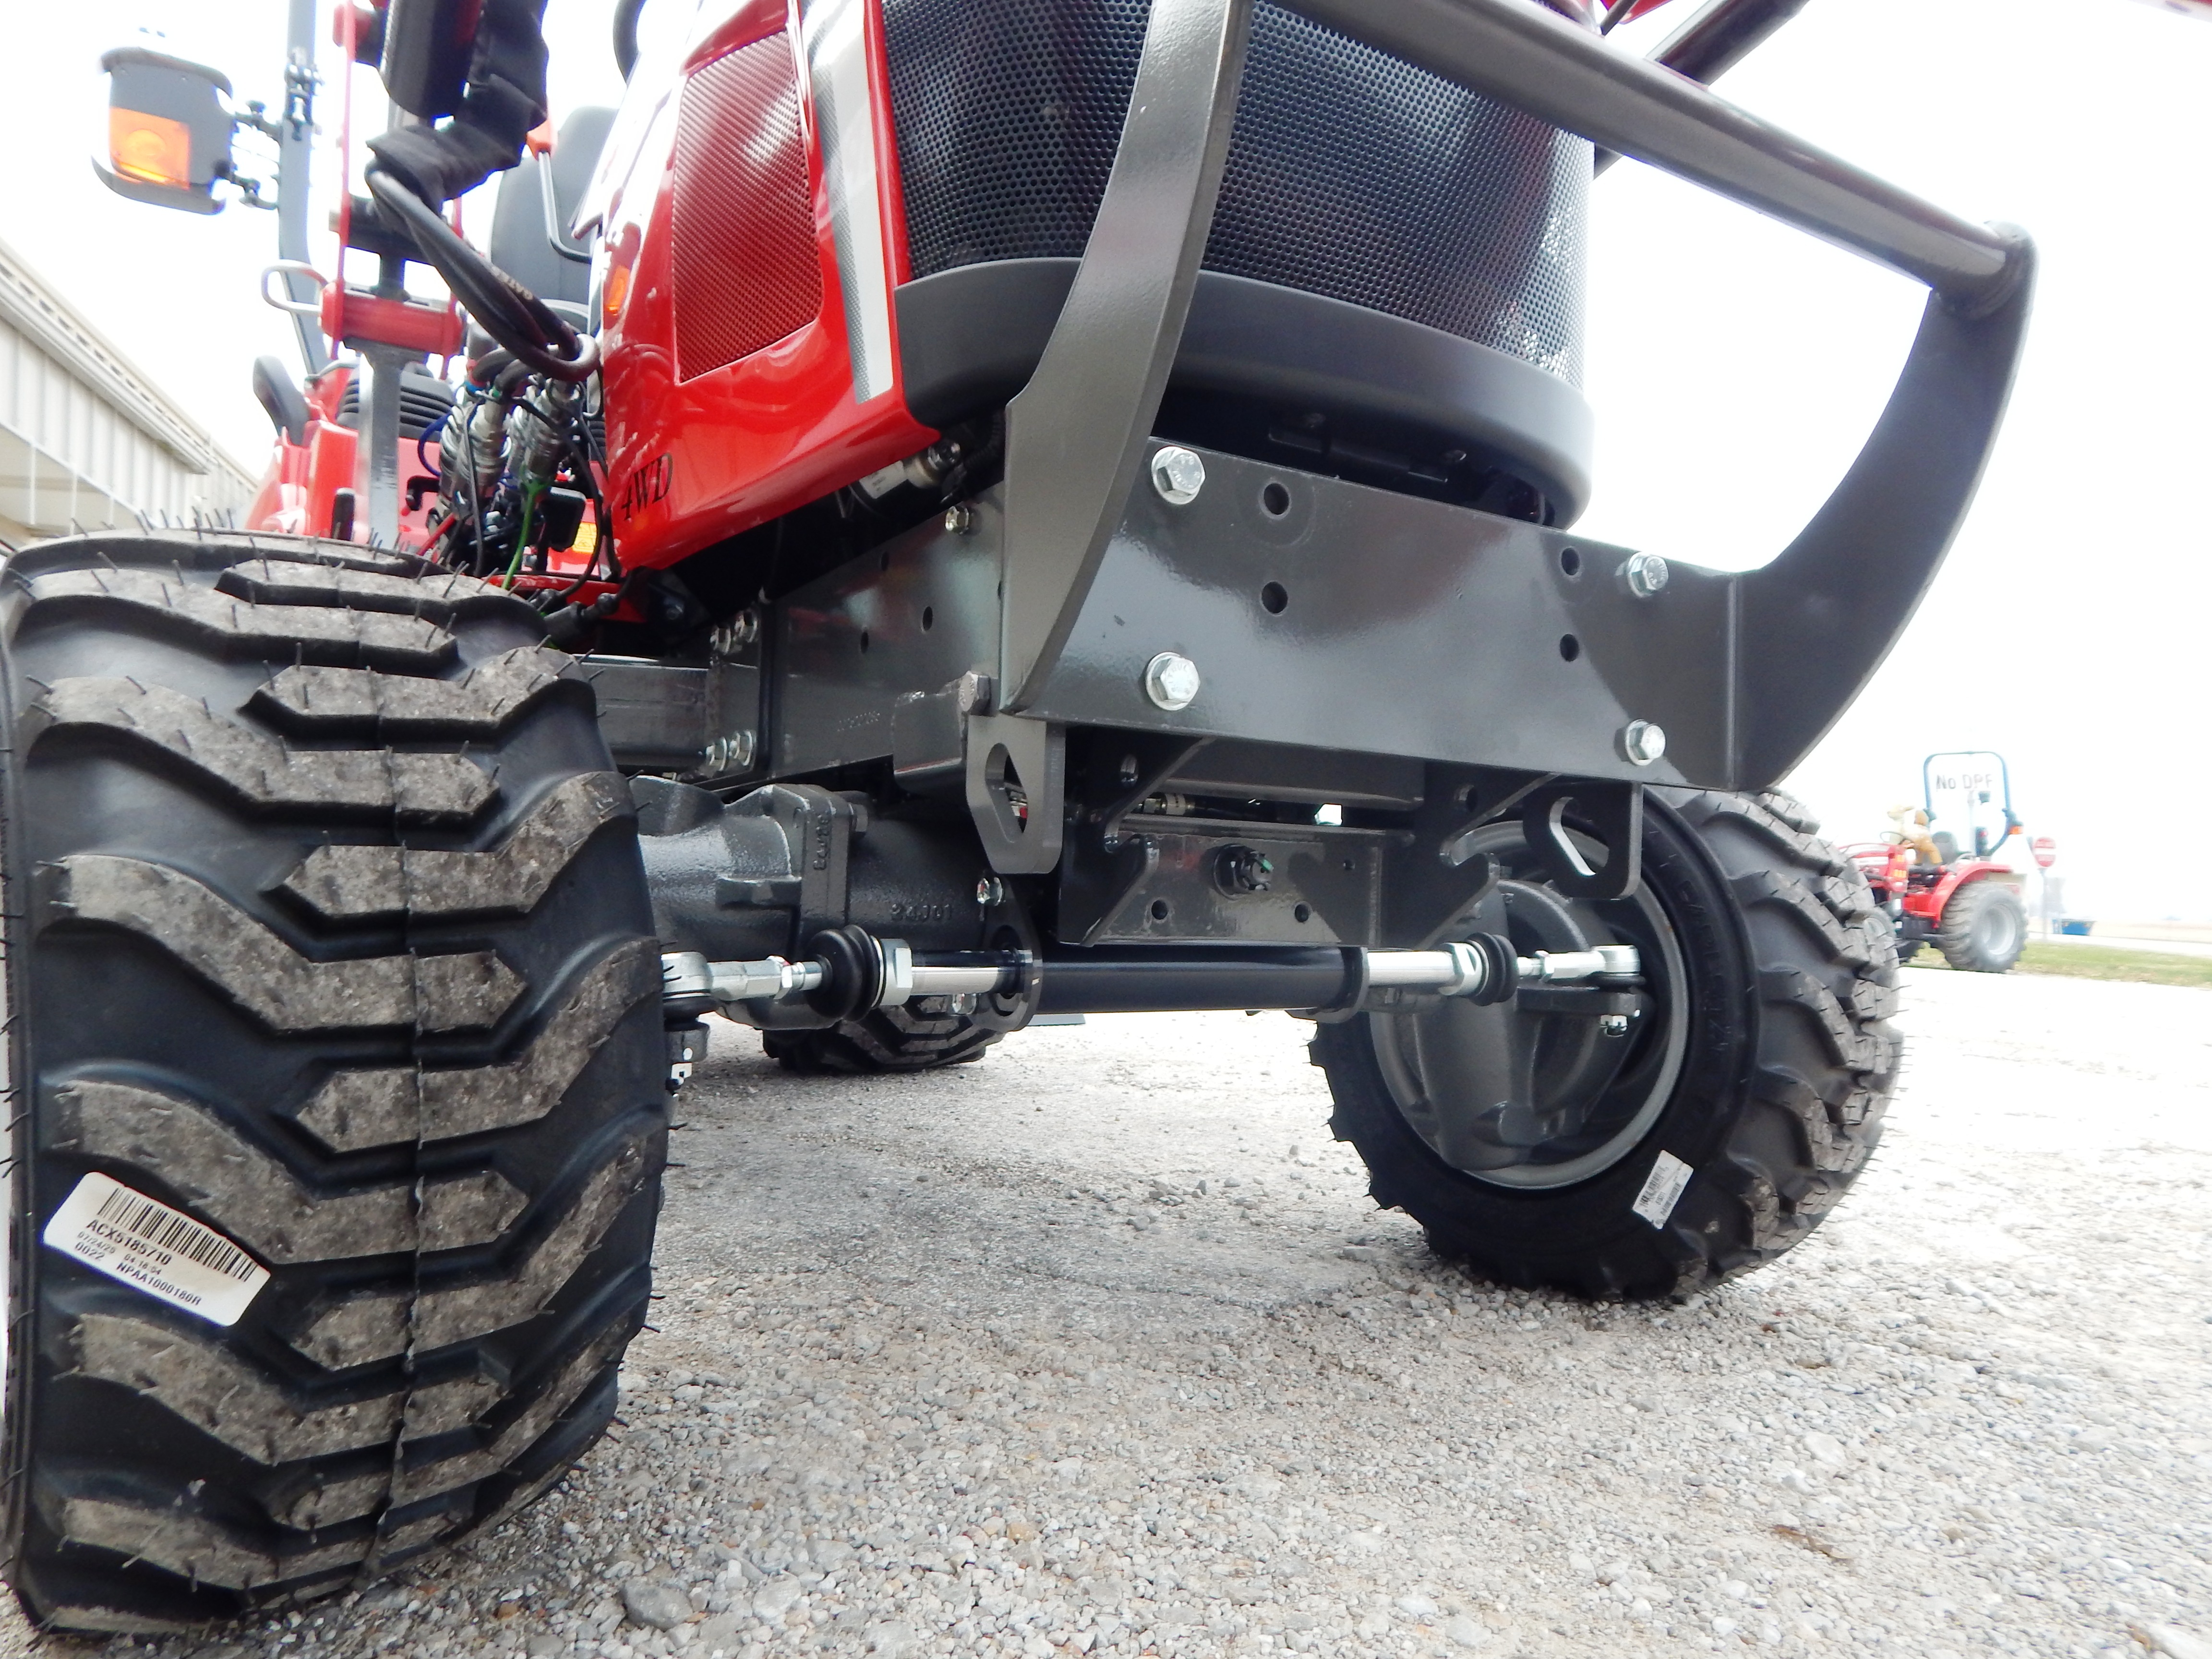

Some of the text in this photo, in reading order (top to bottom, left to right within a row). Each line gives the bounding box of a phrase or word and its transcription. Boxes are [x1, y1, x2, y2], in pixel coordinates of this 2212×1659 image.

[621, 453, 673, 520] 4WD
[1936, 774, 1993, 789] No DPF
[76, 1241, 105, 1260] 0022
[86, 1219, 172, 1265] ACX5185710
